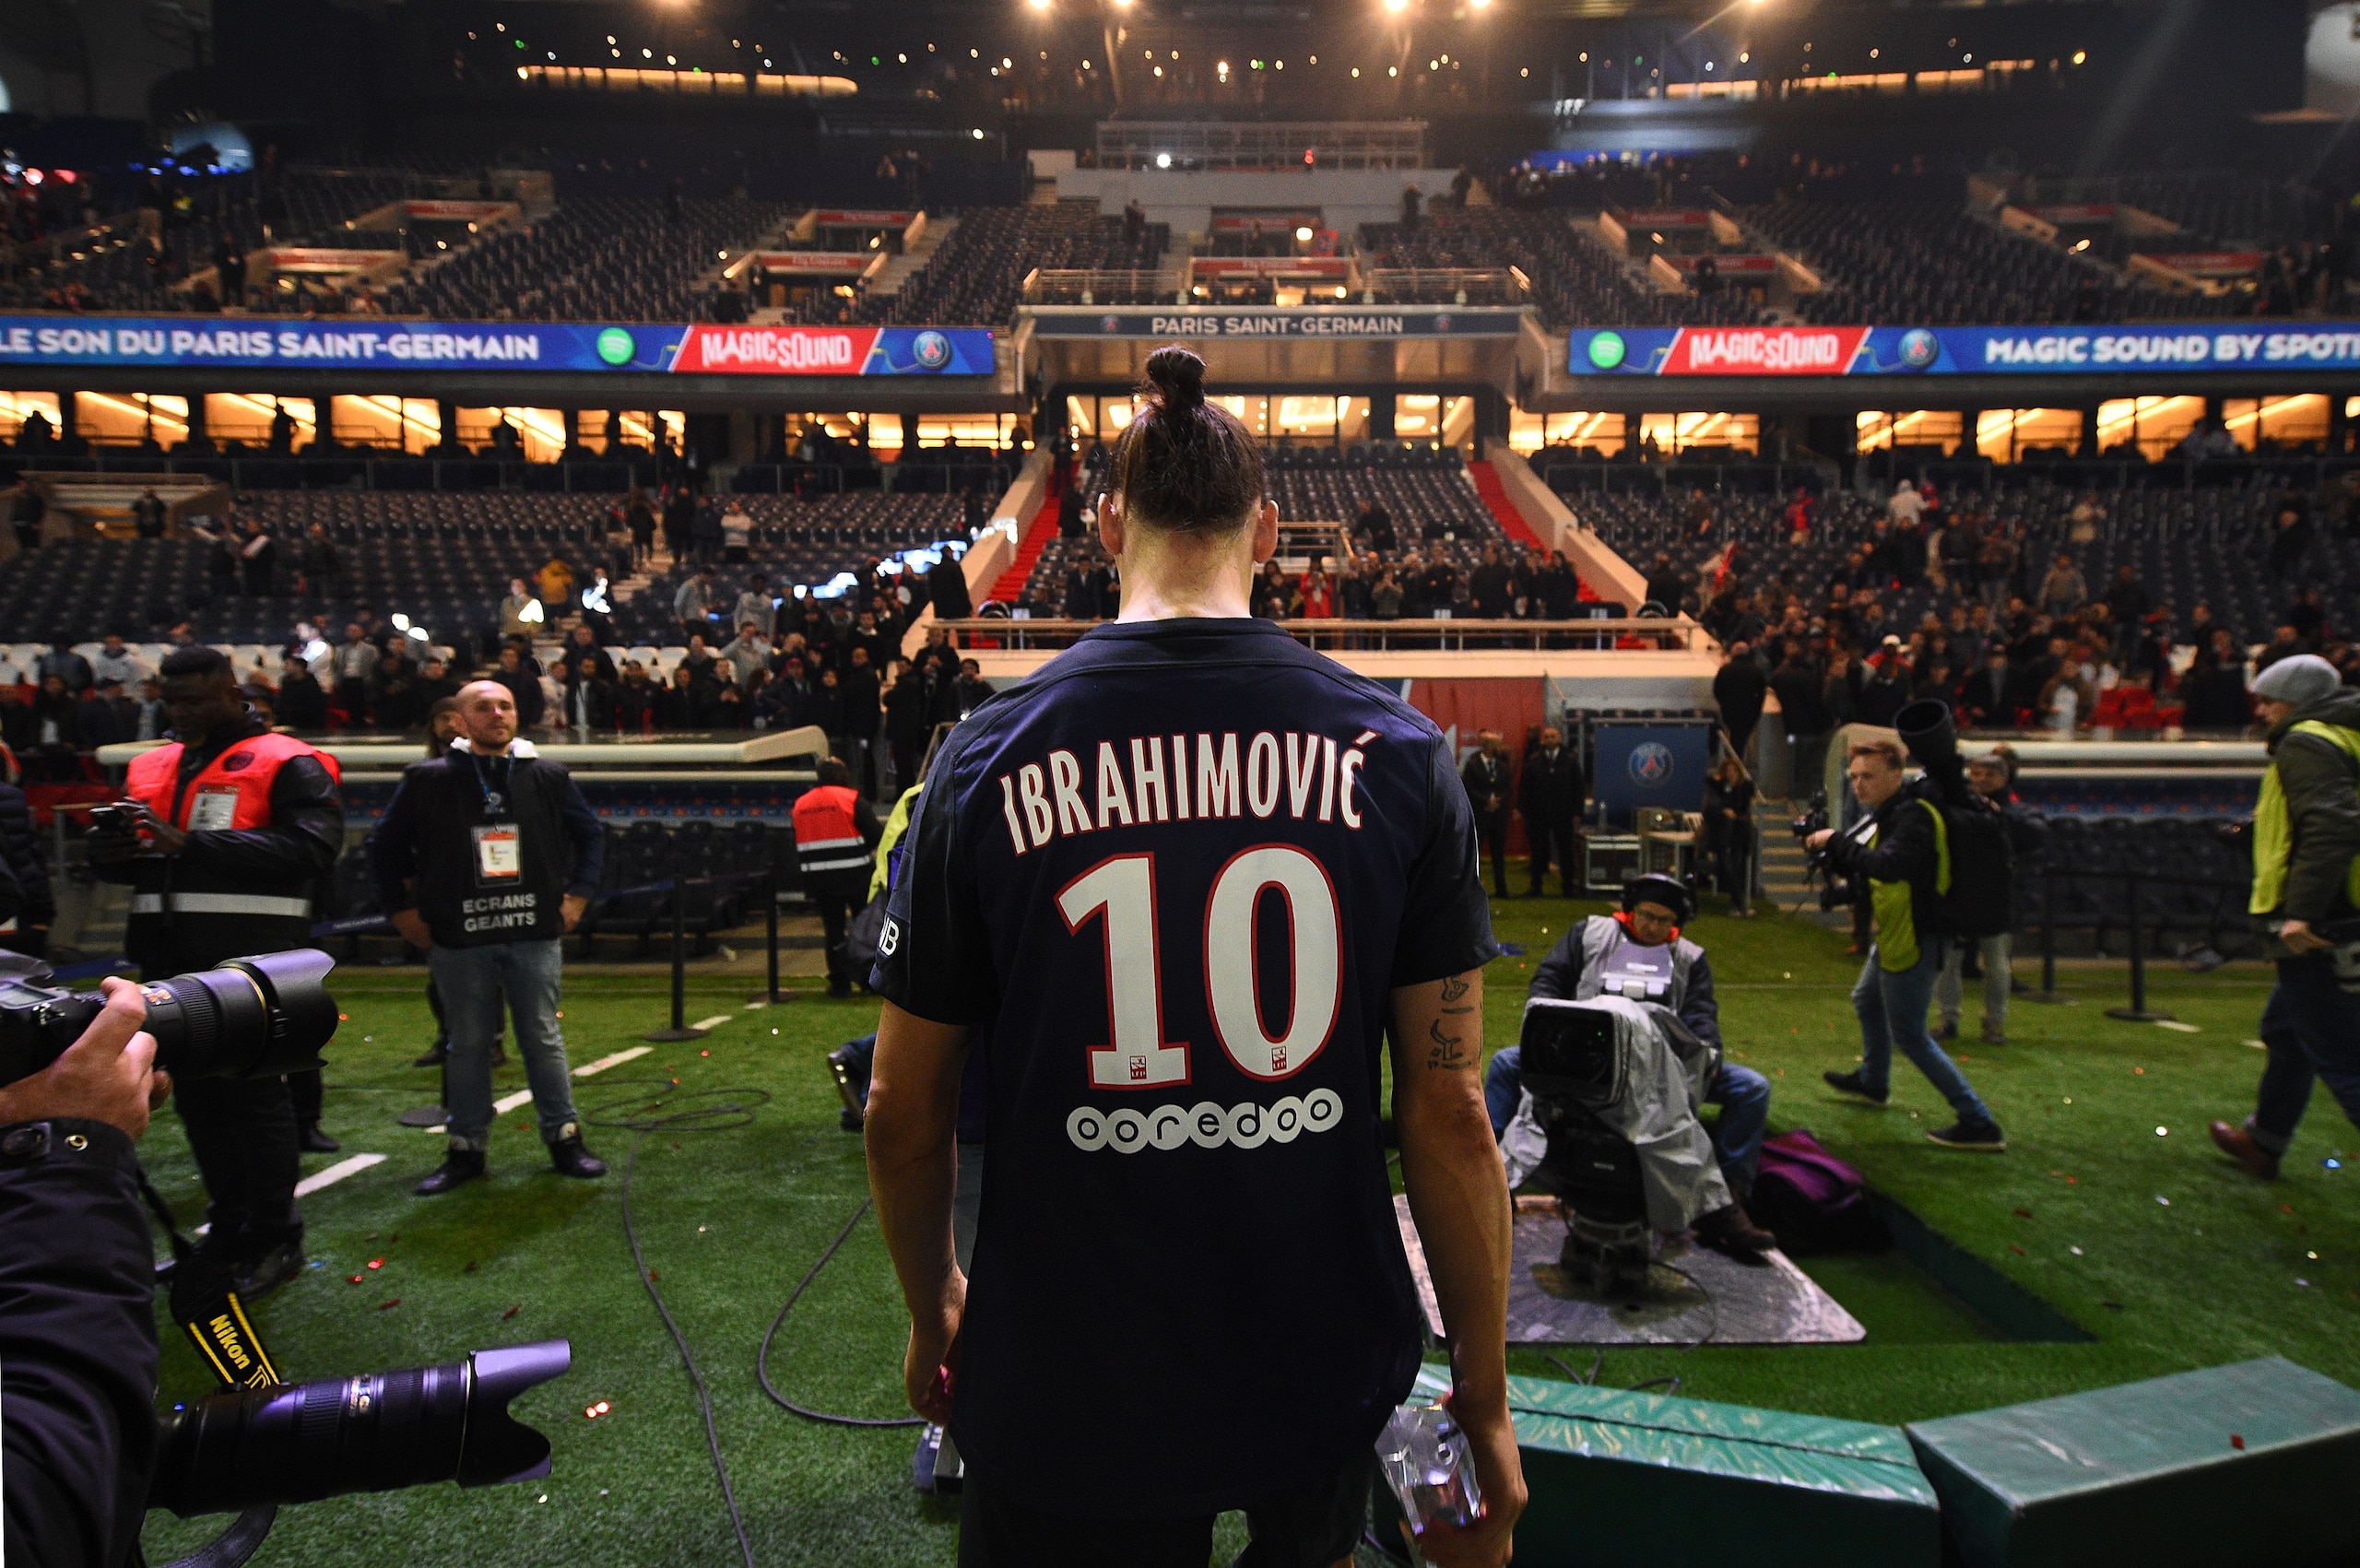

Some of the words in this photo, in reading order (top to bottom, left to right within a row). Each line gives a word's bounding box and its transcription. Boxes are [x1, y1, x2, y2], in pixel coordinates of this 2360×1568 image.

[1151, 317, 1219, 334] PARIS
[1224, 316, 1402, 334] SAINT-GERMAIN
[37, 328, 111, 355] SON
[116, 330, 166, 356] DU
[171, 331, 273, 357] PARIS
[277, 332, 539, 360] SAINT-GERMAIN
[1985, 336, 2088, 363] MAGIC
[2092, 335, 2209, 363] SOUND
[2213, 334, 2264, 361] BY
[999, 730, 1380, 855] IBRAHIMOVIĆ
[463, 892, 537, 914] ECRANS
[464, 912, 537, 932] GEANTS
[1054, 843, 1343, 1090] 10
[1071, 1091, 1340, 1151] ooredoo
[209, 1314, 251, 1370] Nikon
